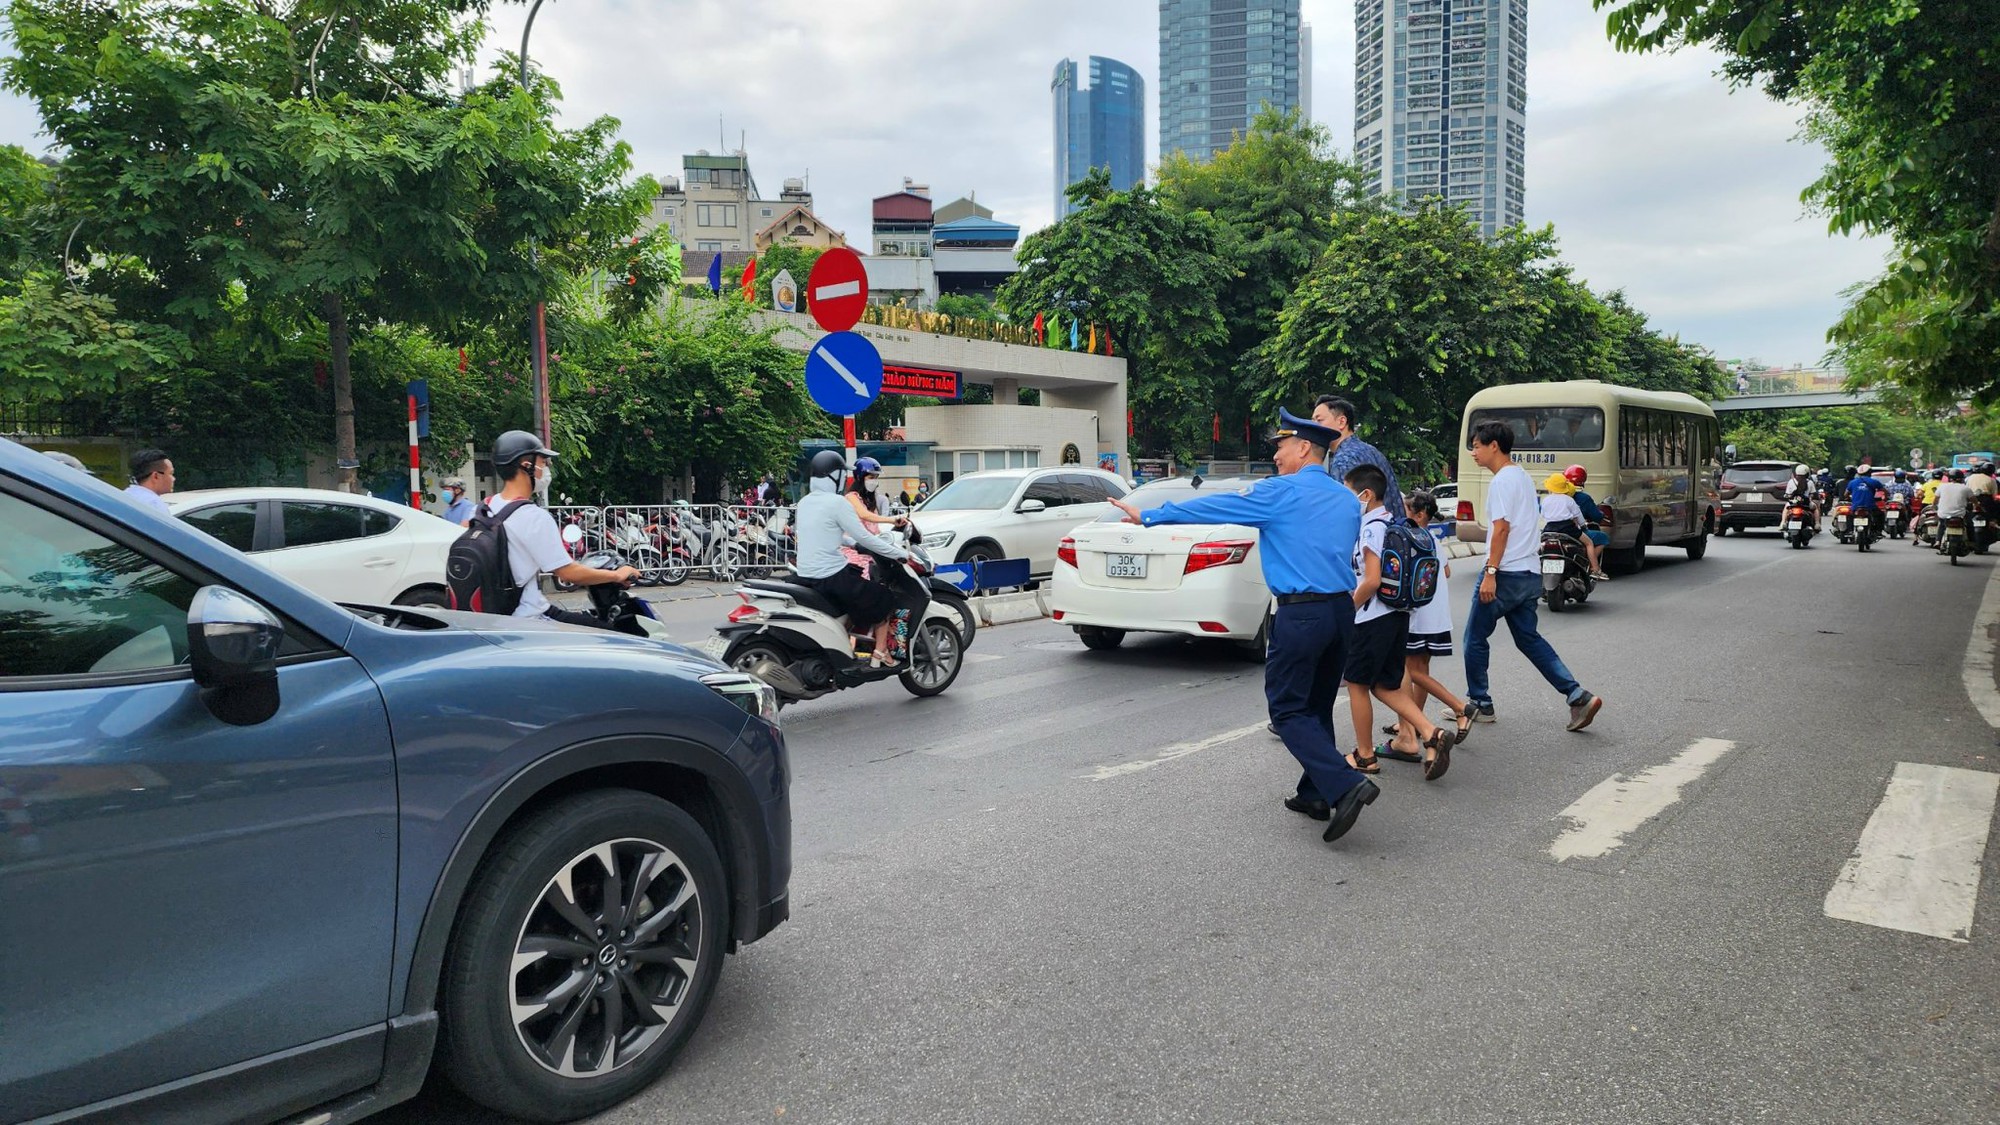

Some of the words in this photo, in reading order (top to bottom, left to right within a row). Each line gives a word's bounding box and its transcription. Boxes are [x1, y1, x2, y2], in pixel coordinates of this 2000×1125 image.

[882, 371, 906, 387] CHÀO
[907, 373, 934, 389] MỪNG
[935, 376, 954, 390] NĂM
[1118, 555, 1135, 565] 30K
[1110, 565, 1141, 576] 039.21
